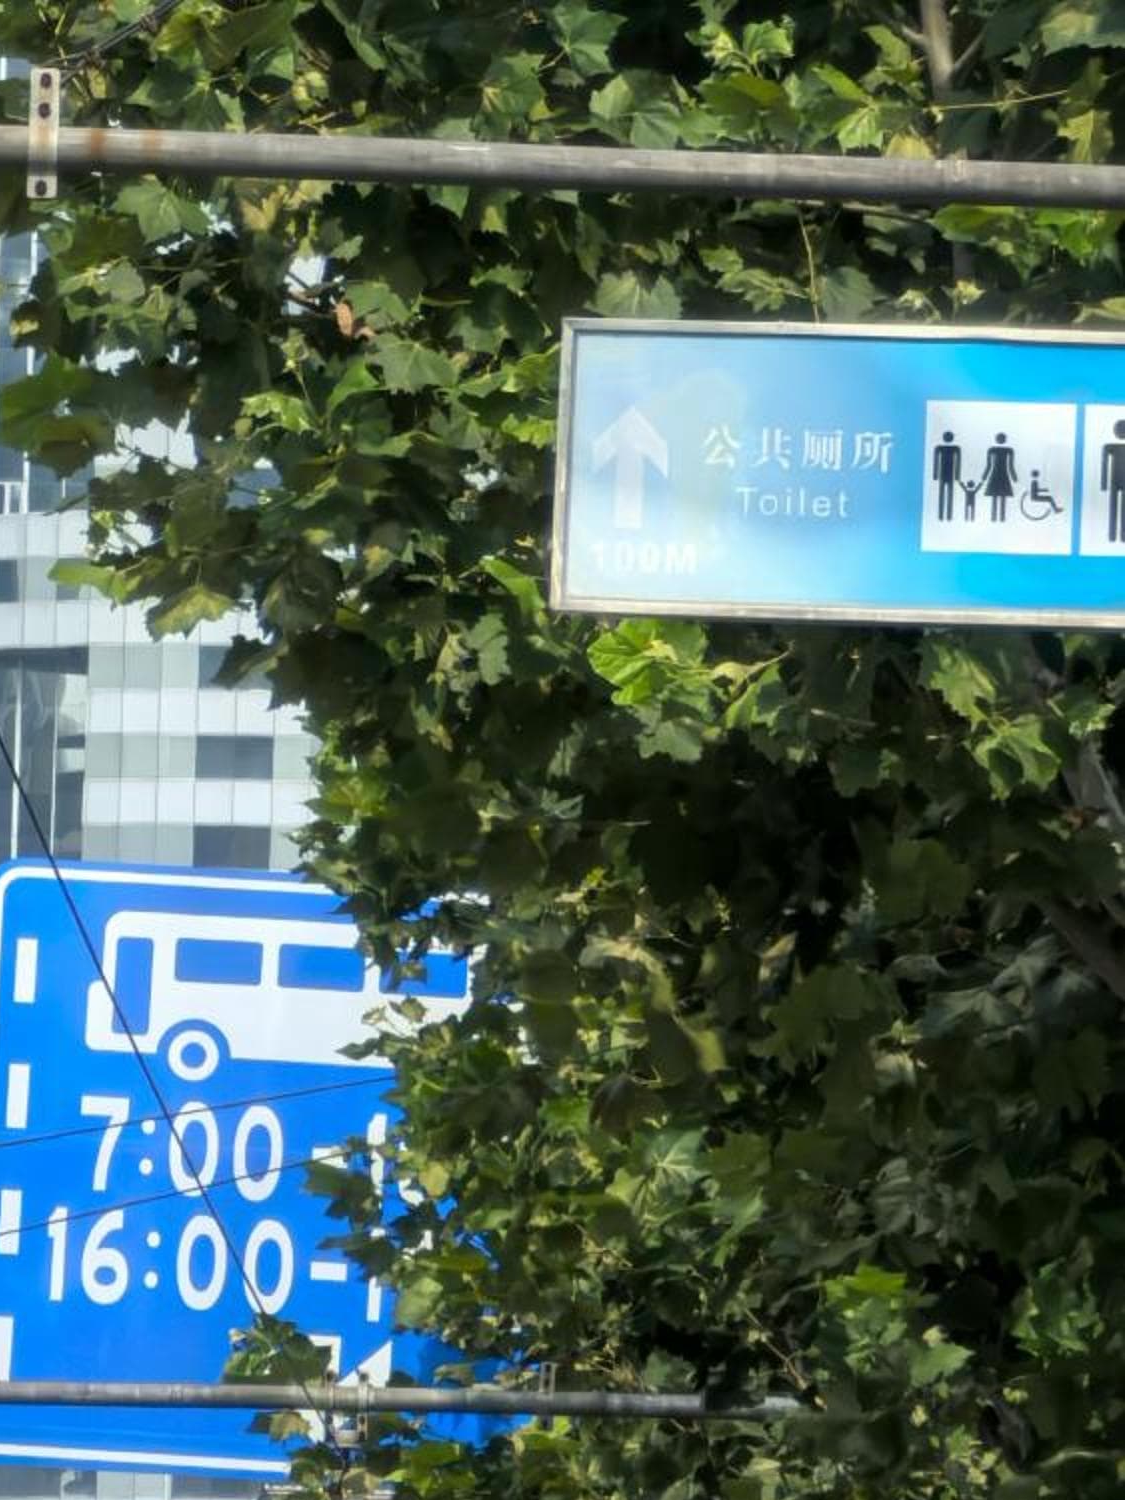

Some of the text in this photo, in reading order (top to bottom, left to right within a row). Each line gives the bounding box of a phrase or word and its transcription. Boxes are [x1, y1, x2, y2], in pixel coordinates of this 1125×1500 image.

[704, 423, 894, 473] 公共厕所
[735, 485, 850, 518] Toilet
[589, 541, 698, 576] 100M
